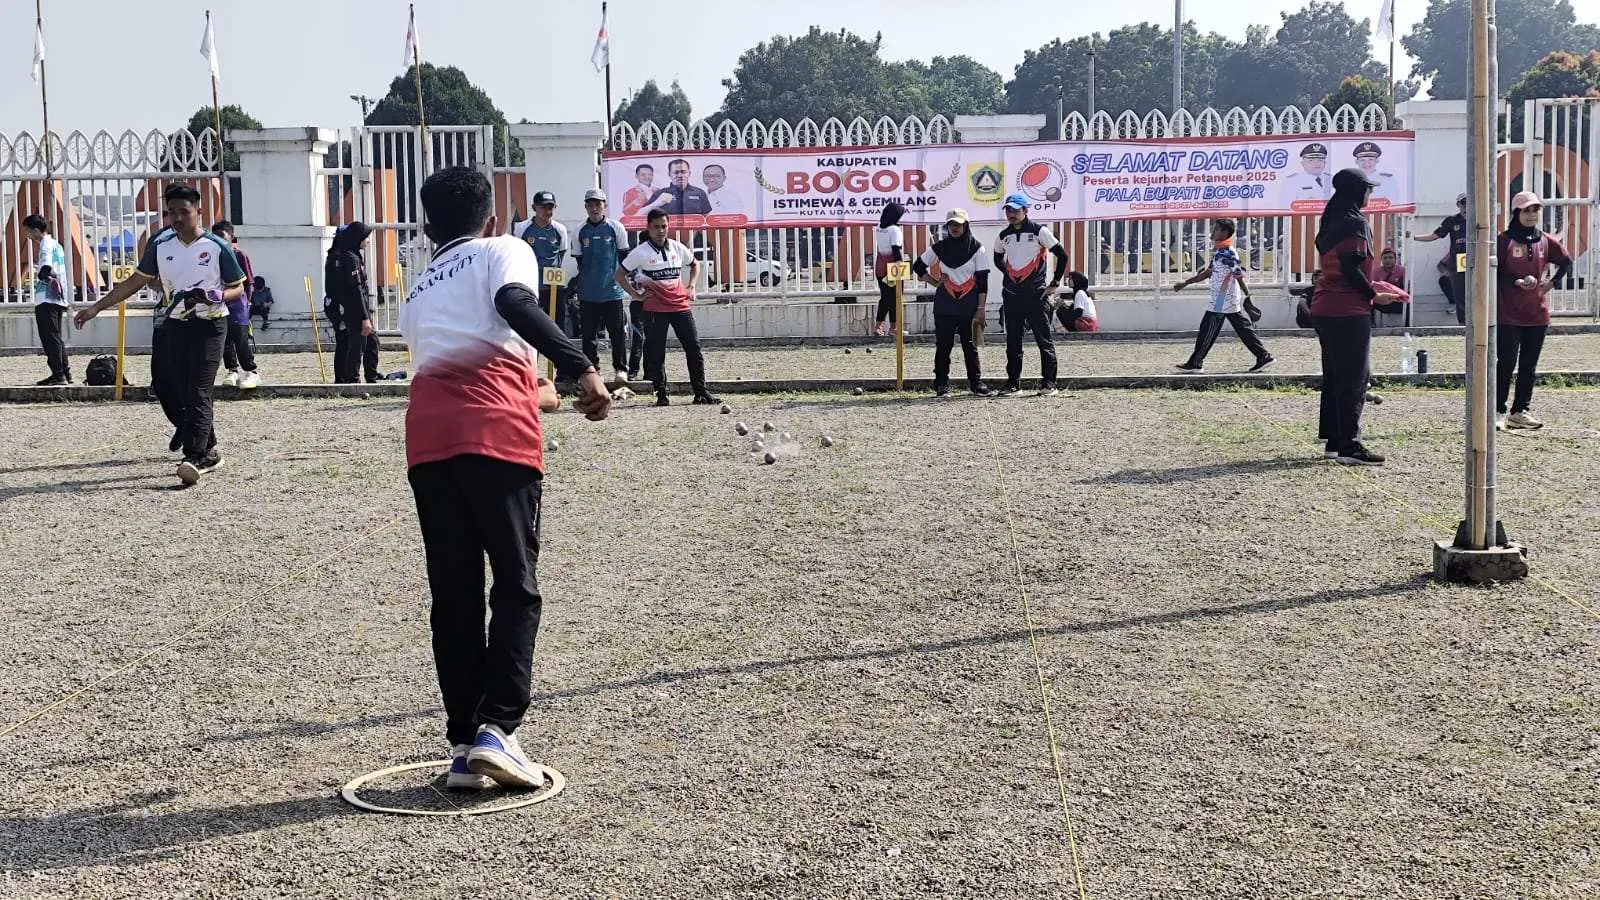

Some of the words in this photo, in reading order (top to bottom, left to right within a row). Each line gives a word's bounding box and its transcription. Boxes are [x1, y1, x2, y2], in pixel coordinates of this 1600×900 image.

[817, 157, 897, 167] KABUPATEN
[1071, 152, 1186, 174] SELAMAT
[1188, 149, 1288, 171] DATANG
[786, 170, 927, 194] BOGOR
[1082, 175, 1130, 186] Peserta
[1132, 173, 1184, 186] kejurbar
[1186, 173, 1243, 186] Petanque
[1246, 171, 1277, 182] 2025
[1095, 188, 1142, 202] PIALA
[1144, 186, 1200, 201] BUPATI
[1202, 185, 1264, 200] BOGOR
[773, 198, 843, 209] ISTIMEWA
[848, 197, 858, 208] &
[862, 196, 937, 208] GEMILANG
[829, 208, 862, 216] UDAYA
[115, 267, 131, 279] 05
[547, 269, 562, 282] 06
[891, 264, 906, 277] 07
